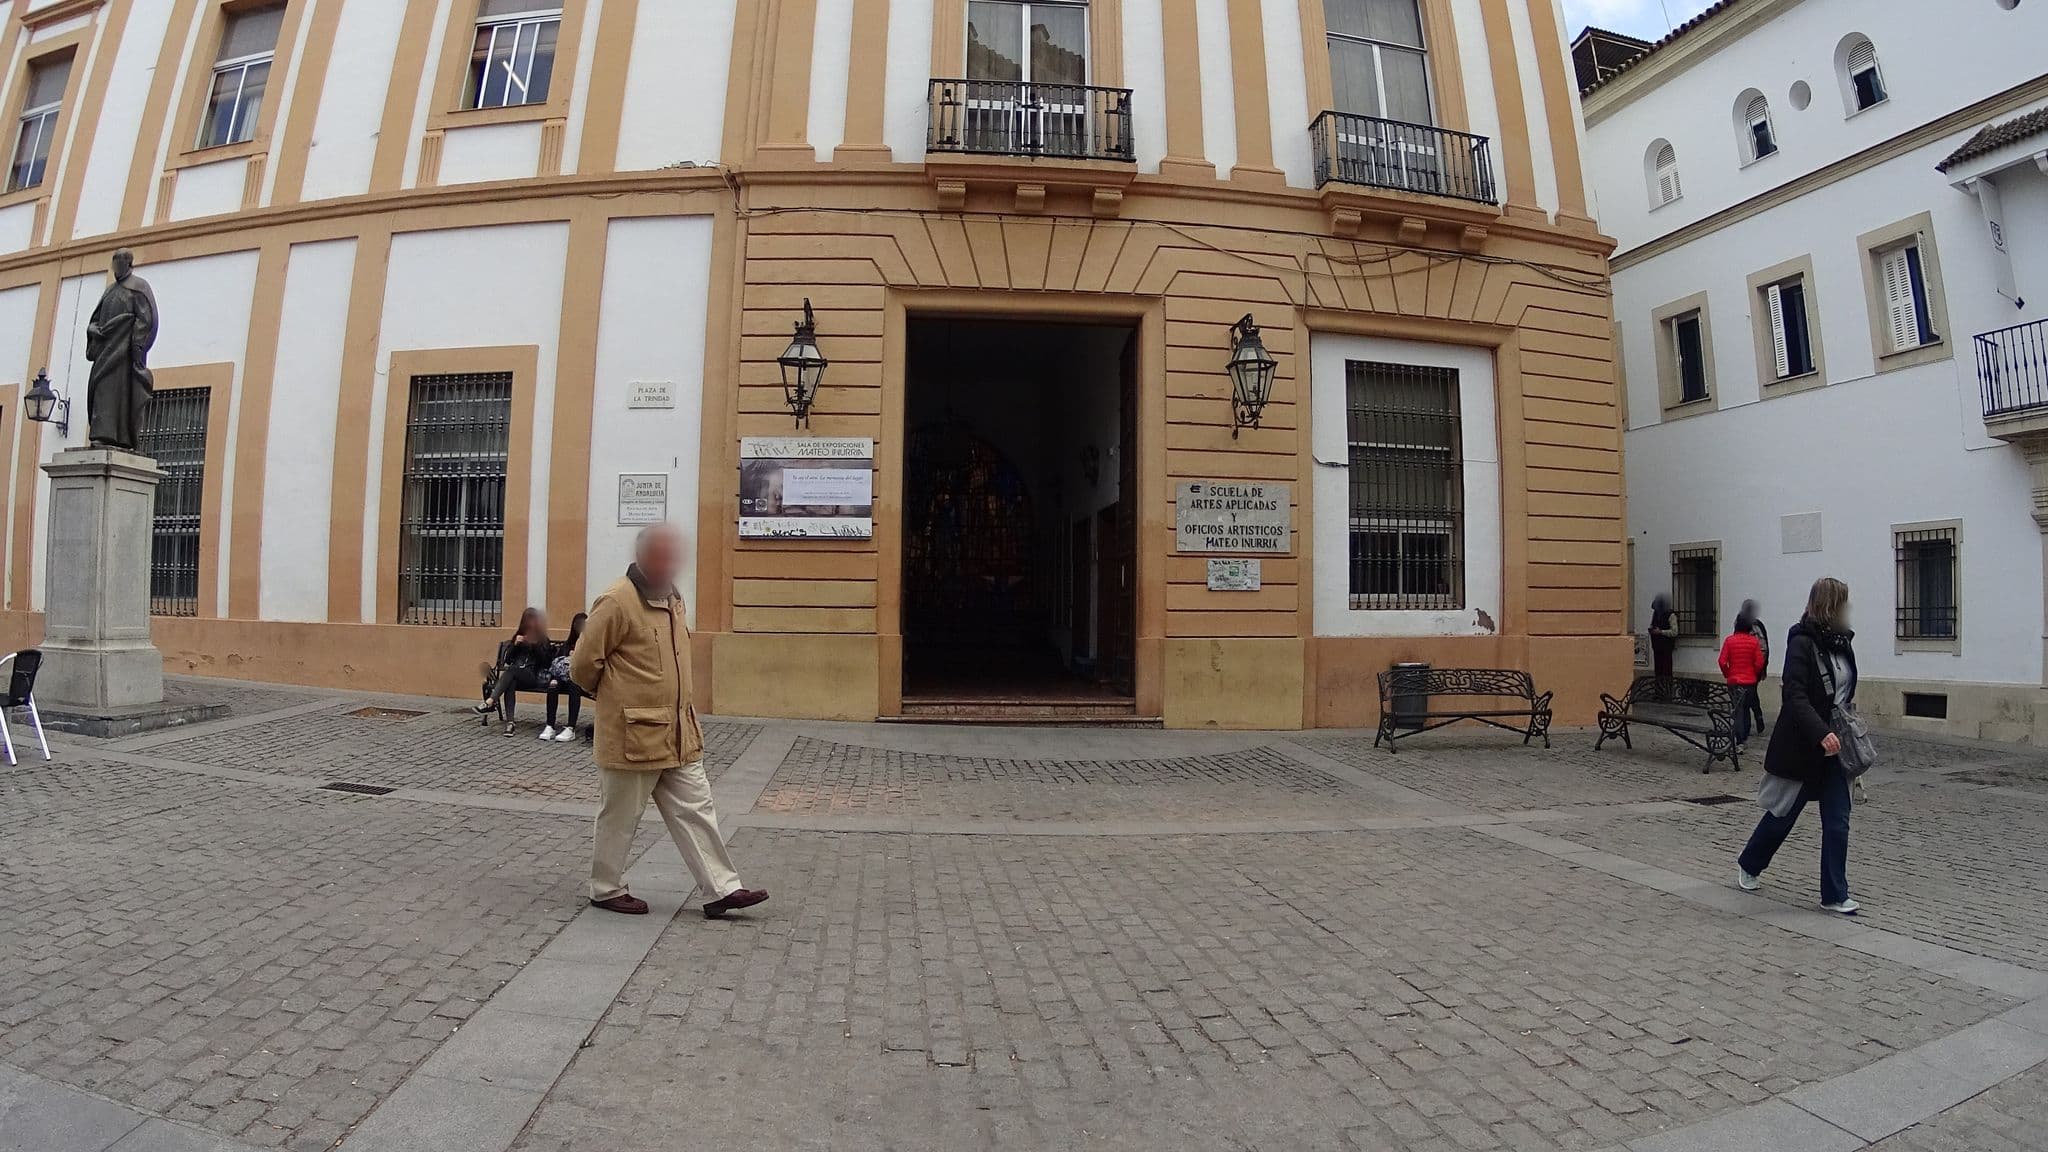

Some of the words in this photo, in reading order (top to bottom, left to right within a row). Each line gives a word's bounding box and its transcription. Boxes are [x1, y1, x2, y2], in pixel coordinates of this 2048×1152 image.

[797, 448, 830, 456] MATEO
[832, 448, 865, 456] INURRIA
[1251, 487, 1264, 498] DE
[1190, 499, 1223, 510] ARTES
[1225, 500, 1277, 511] APLICADAS
[1231, 513, 1237, 522] Y
[1185, 524, 1224, 535] OFICIOS
[1227, 525, 1283, 536] ARTISTICOS
[1205, 537, 1239, 549] MATEO
[1241, 538, 1279, 549] INURRIA
